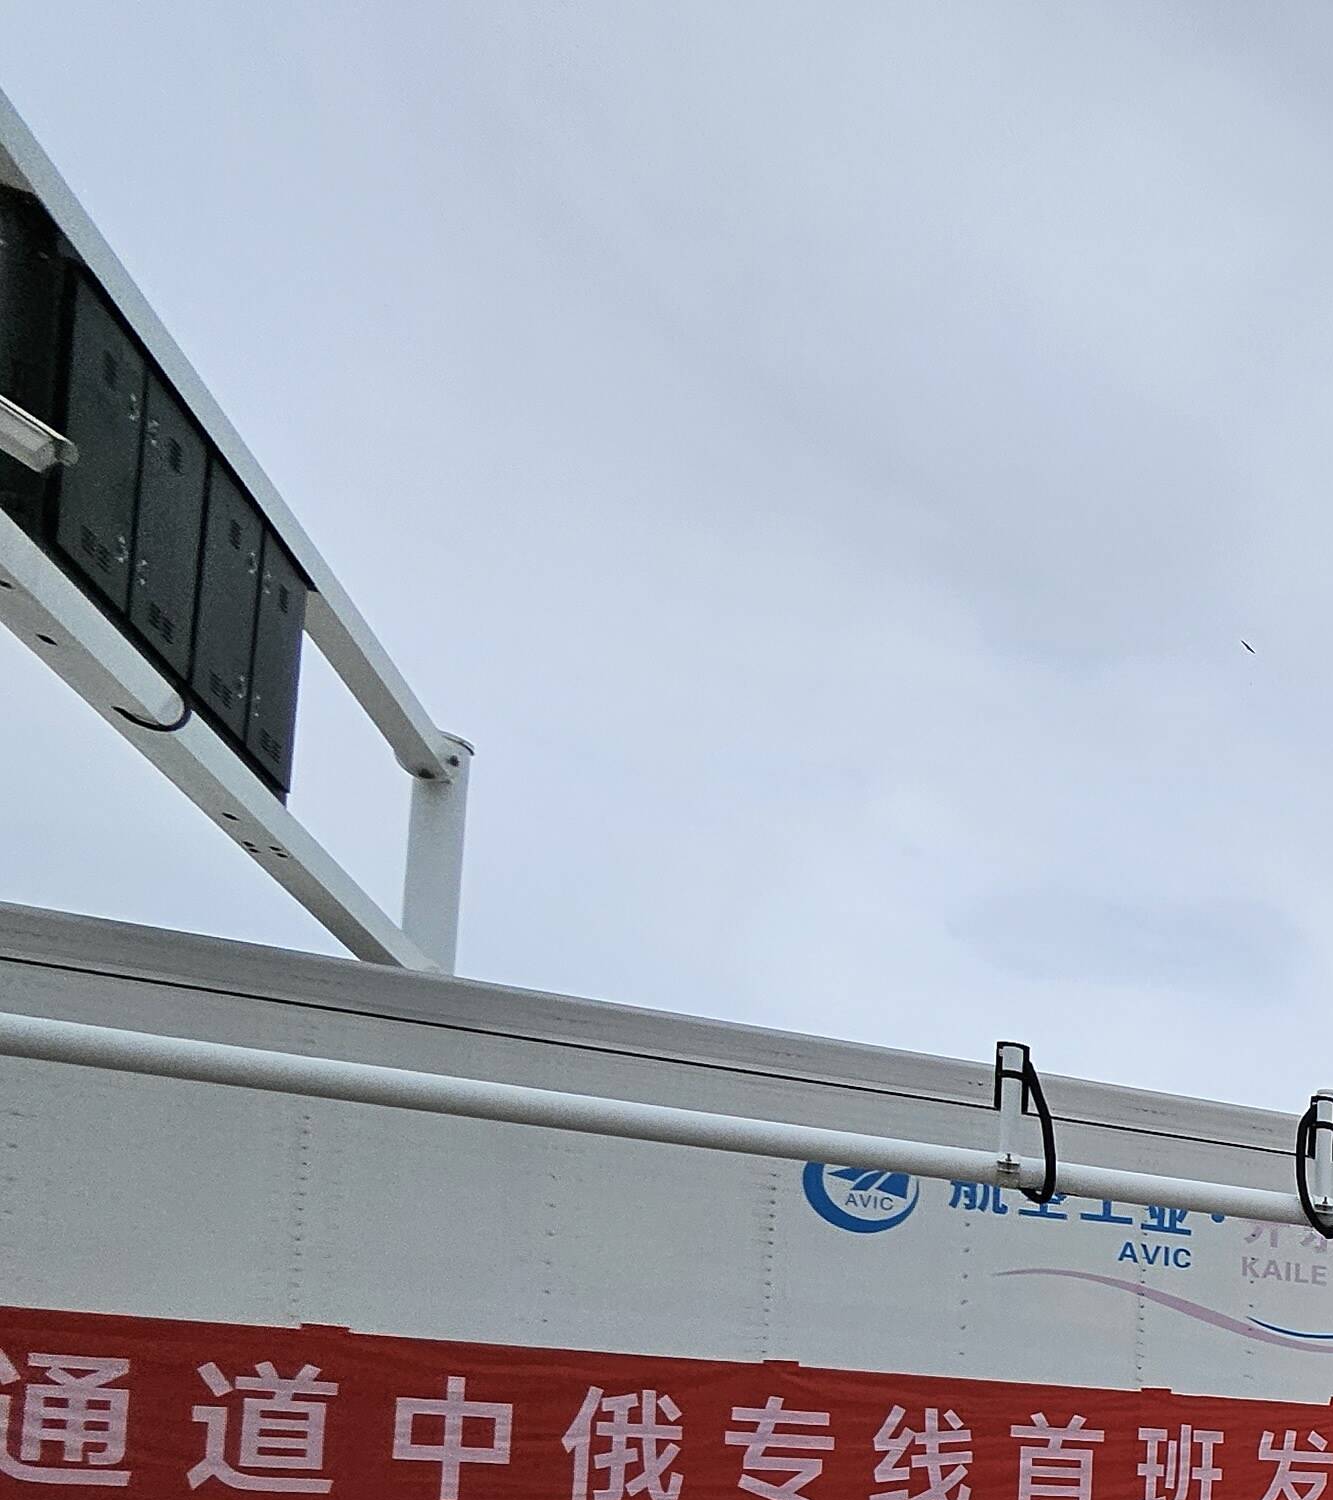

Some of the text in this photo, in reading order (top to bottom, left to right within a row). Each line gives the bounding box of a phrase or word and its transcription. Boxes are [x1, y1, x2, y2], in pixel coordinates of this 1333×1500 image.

[845, 1193, 894, 1212] AVIC
[1118, 1242, 1192, 1269] AVIC
[1241, 1256, 1328, 1287] KAILE
